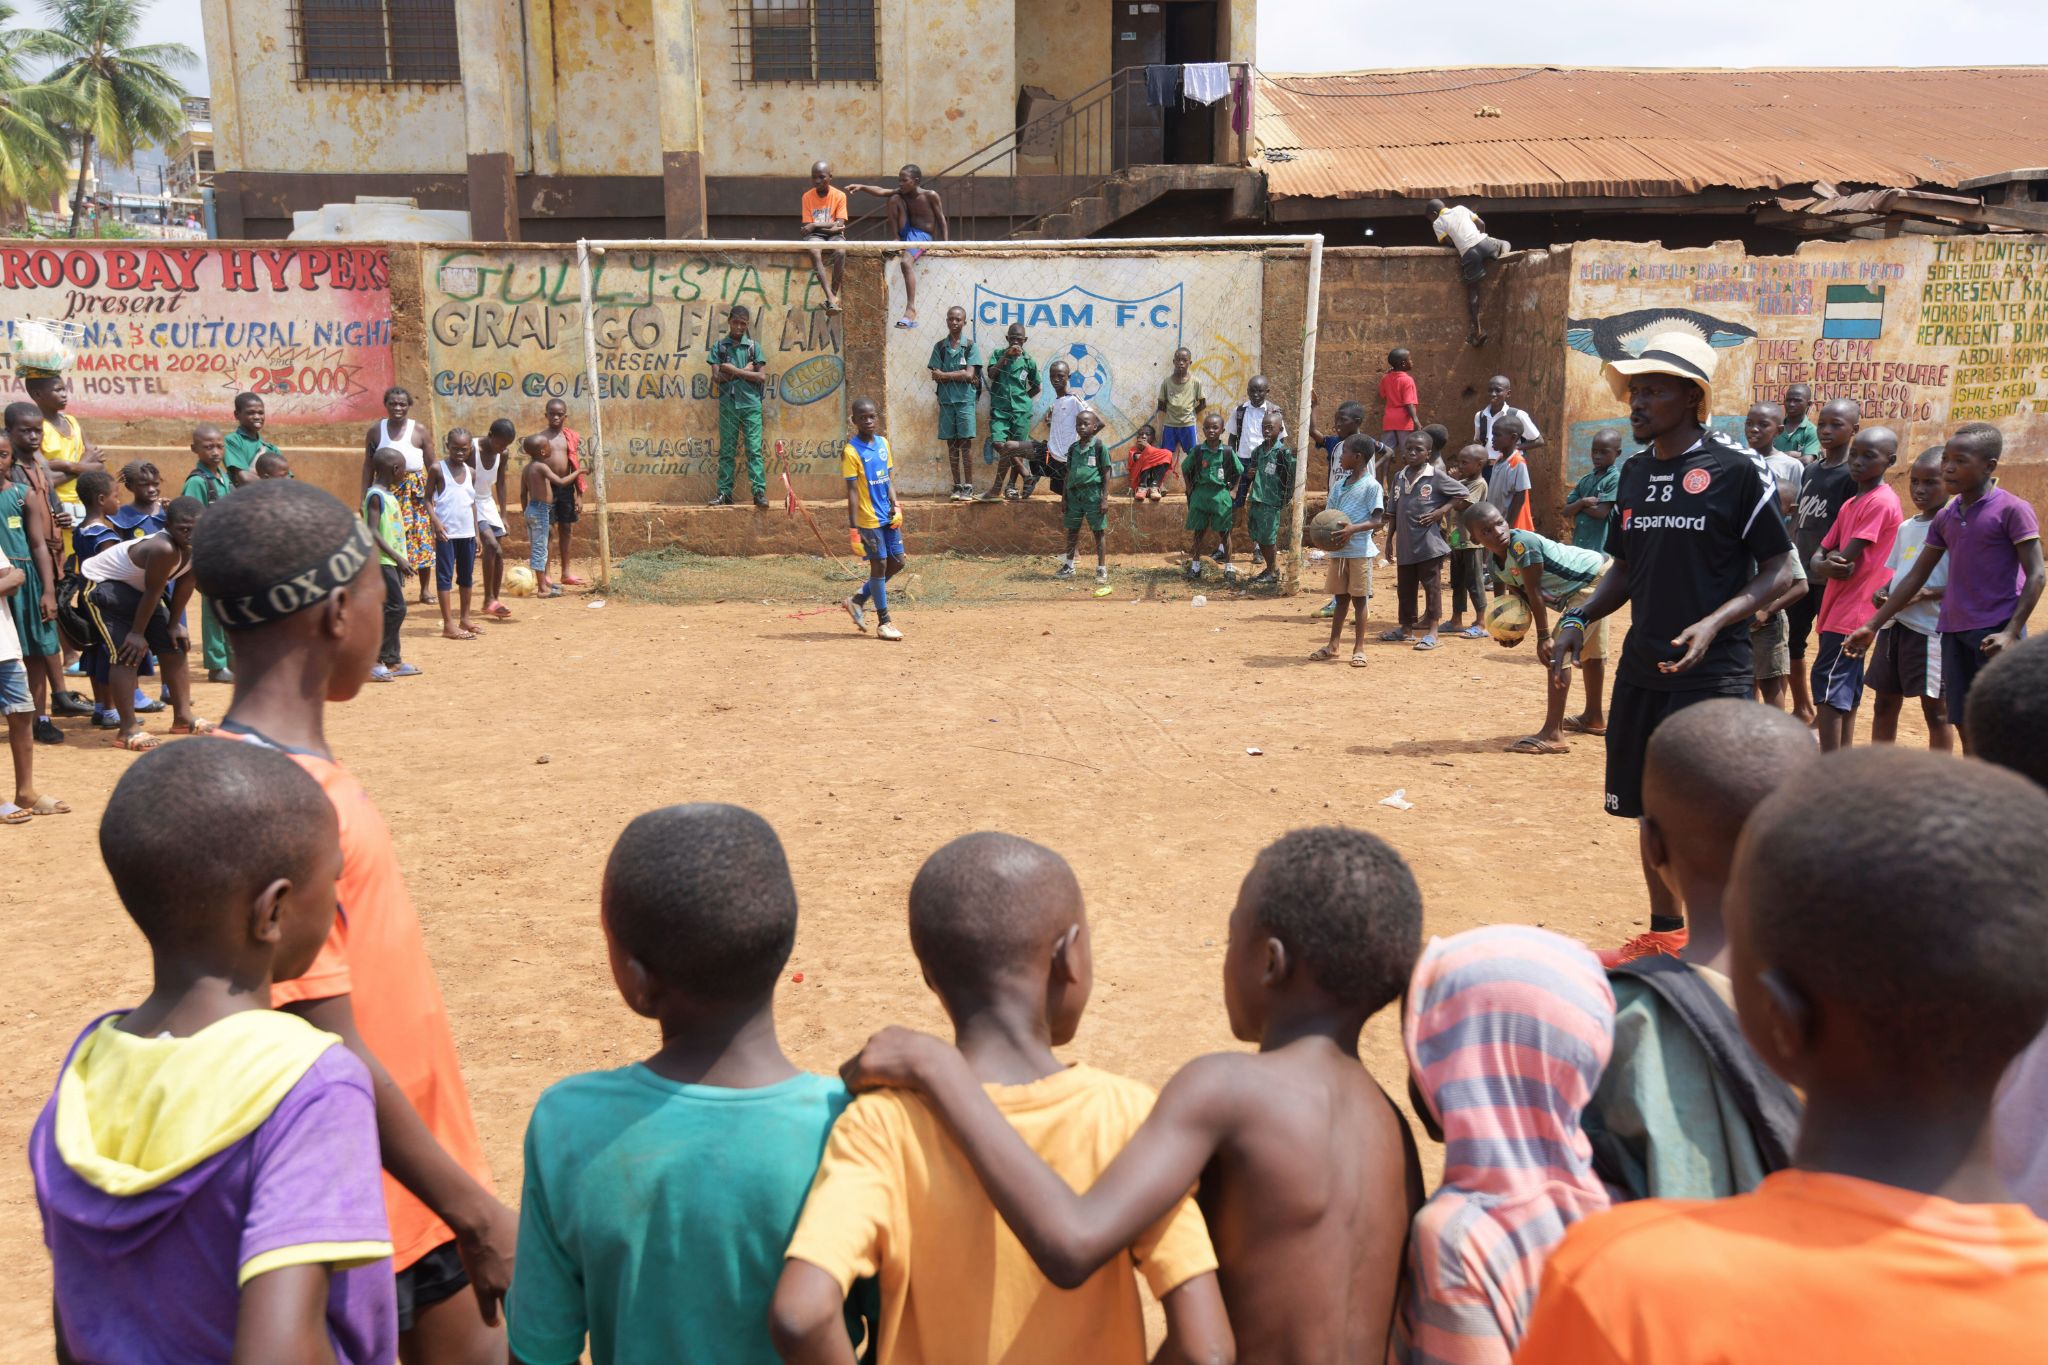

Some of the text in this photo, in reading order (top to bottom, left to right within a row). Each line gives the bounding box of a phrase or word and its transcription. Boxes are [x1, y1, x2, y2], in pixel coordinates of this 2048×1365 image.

[1933, 239, 2048, 263] THE CONTEST
[0, 248, 389, 292] ROO BAY HYPERS
[1922, 280, 2015, 303] REPRESENT
[63, 289, 187, 321] present
[979, 301, 1178, 329] CHAM F.C.
[1920, 303, 1968, 323] MORRIS
[150, 320, 302, 349] CULTURAL
[313, 319, 392, 348] NIGHT
[432, 302, 580, 351] GRAP
[593, 301, 667, 351] GO
[779, 308, 842, 353] AM
[1916, 323, 2003, 347] REPRESENT
[77, 353, 159, 372] MARCH
[166, 352, 227, 373] 2020
[270, 357, 295, 366] PRICE
[595, 352, 688, 371] PRESENT
[1815, 362, 1881, 383] REGENT
[83, 376, 168, 395] HOSTEL
[434, 370, 514, 397] GRAP
[522, 372, 569, 398] GO
[637, 374, 686, 400] AM
[692, 373, 781, 401] BEH
[1955, 366, 2029, 386] REPRESENT
[1951, 401, 2020, 420] REPRESENT
[1649, 473, 1675, 483] hummel
